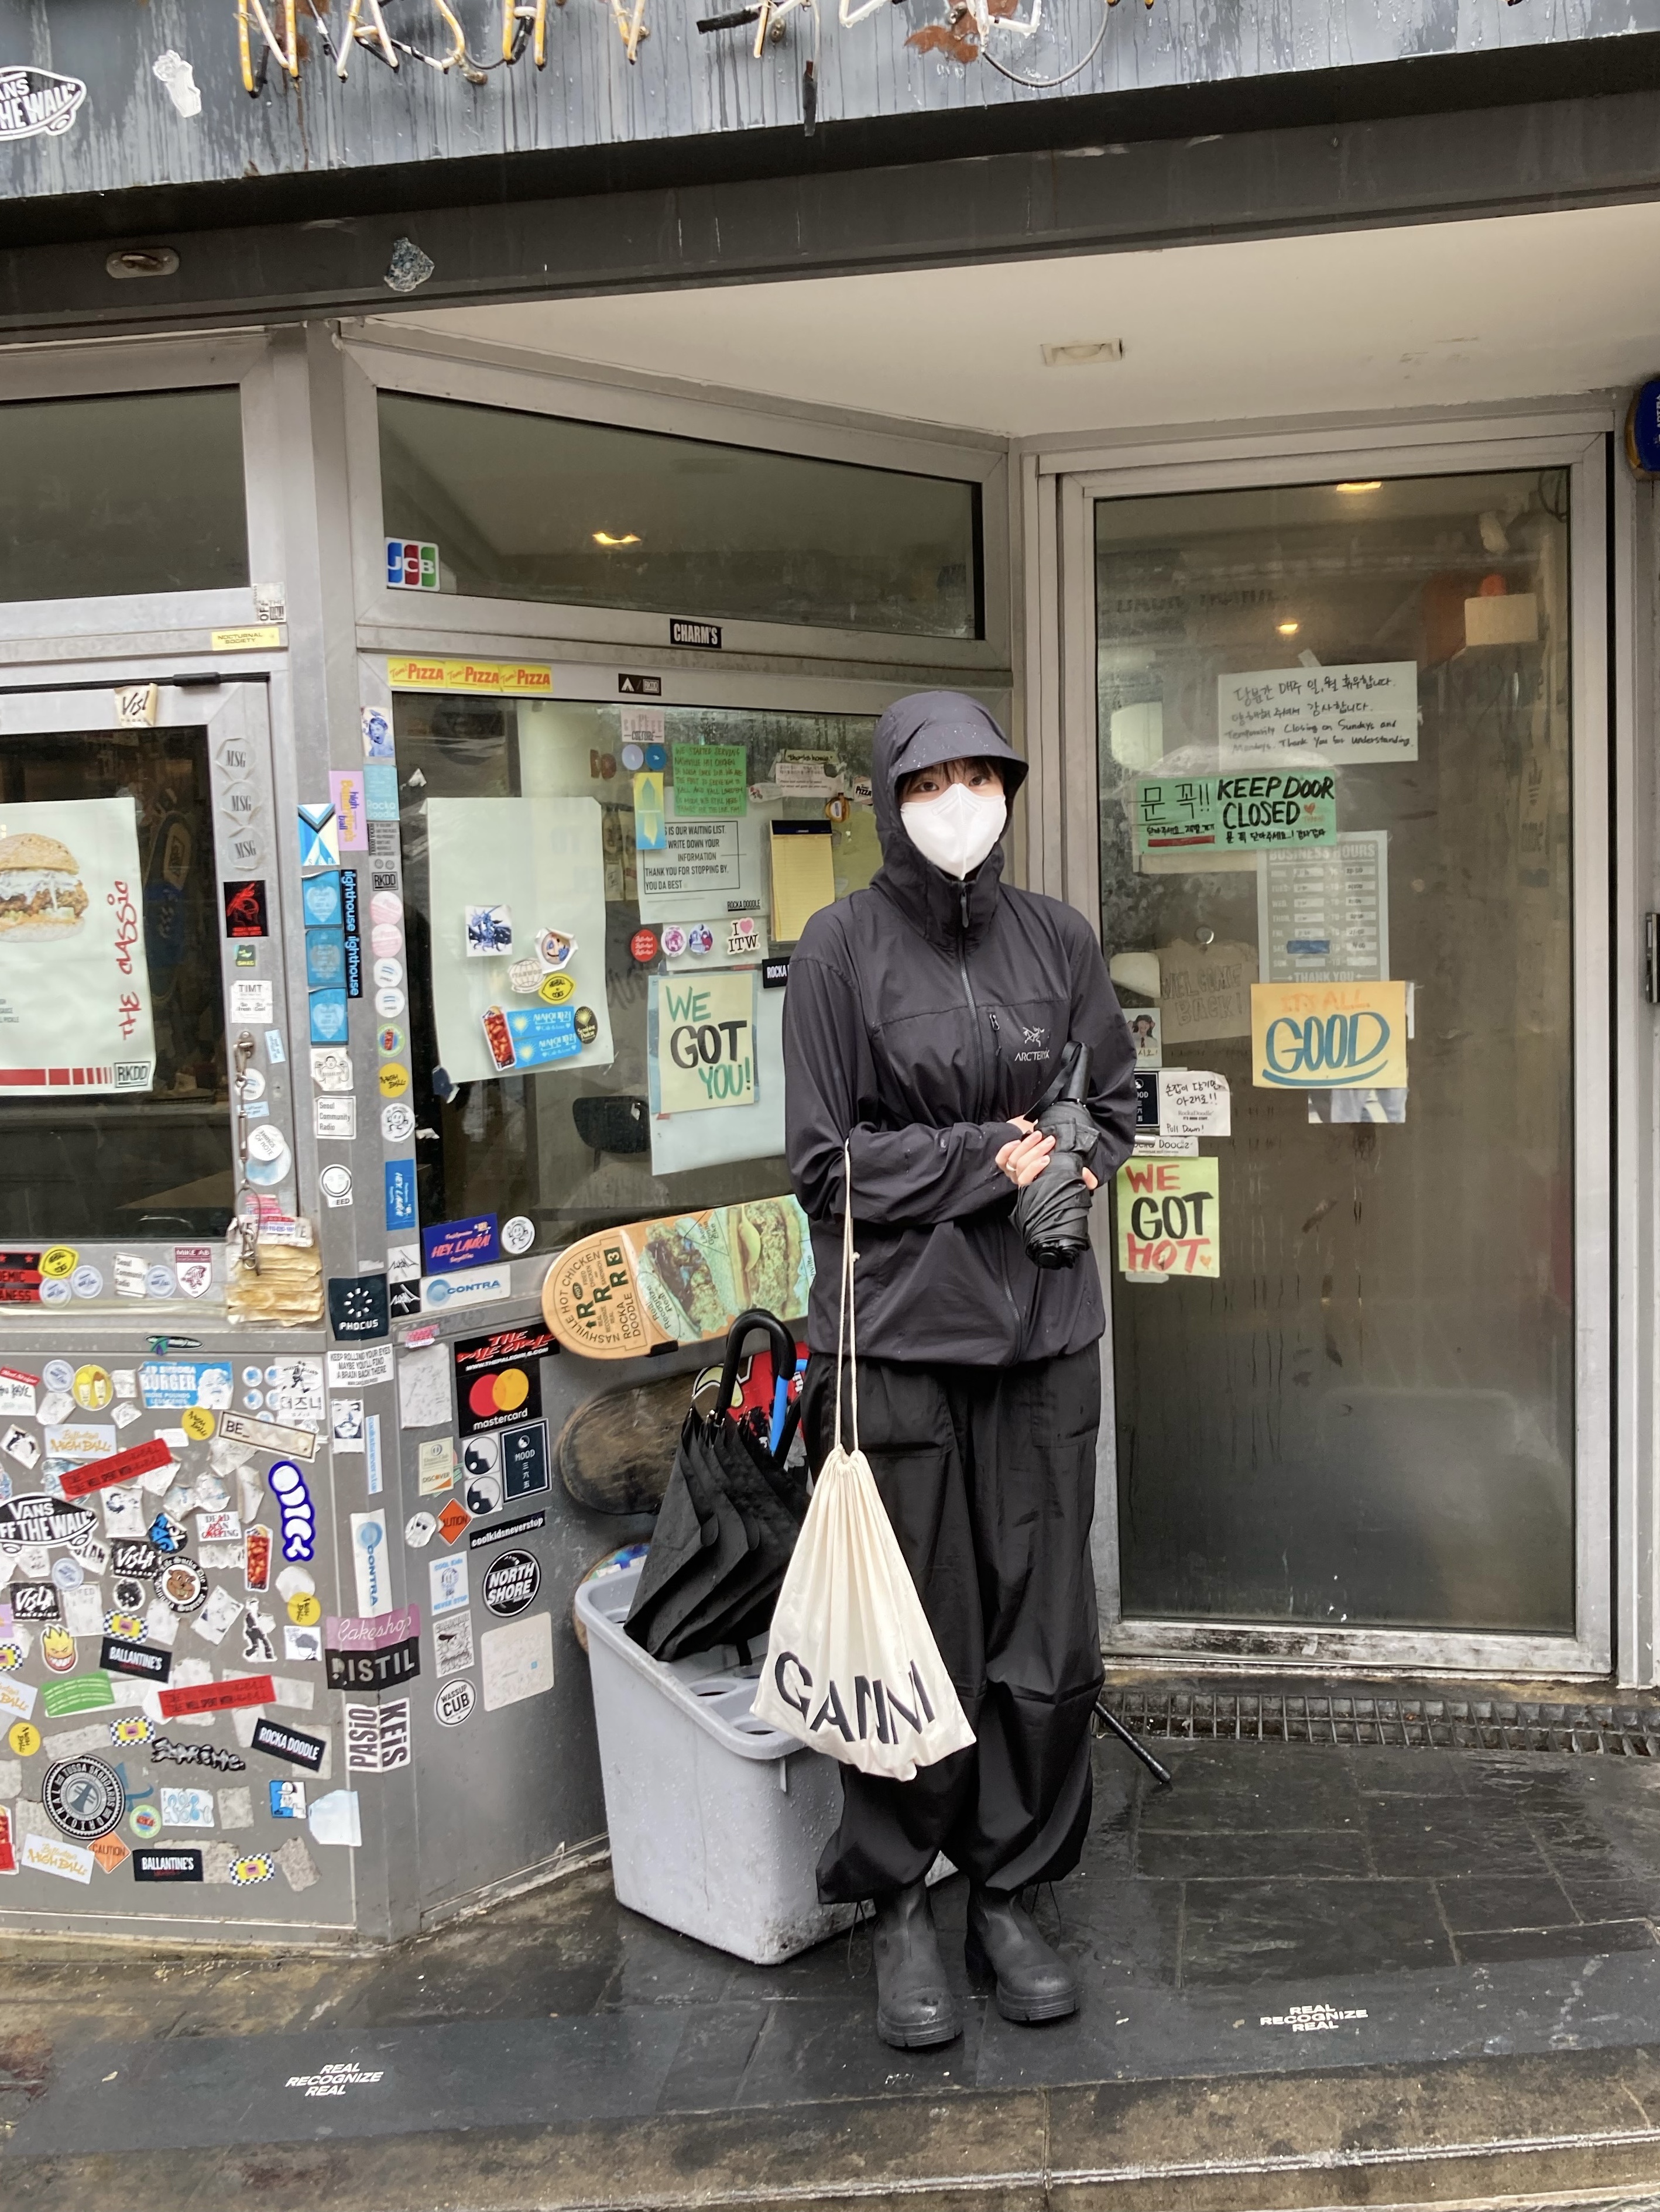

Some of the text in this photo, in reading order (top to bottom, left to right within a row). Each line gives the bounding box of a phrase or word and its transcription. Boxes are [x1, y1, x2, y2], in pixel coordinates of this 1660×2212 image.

[387, 555, 435, 575] JCB
[217, 633, 263, 641] NOCTURNAL
[673, 623, 718, 645] CHARM'S
[408, 662, 444, 680] PIZZA
[465, 666, 499, 684] PIZZA
[517, 669, 551, 685] PIZZA
[1279, 682, 1302, 695] 매주
[1284, 723, 1318, 734] Closing
[1337, 719, 1374, 732] Sundays
[1380, 720, 1397, 728] and
[1279, 738, 1309, 748] Thank
[225, 751, 246, 768] MSG
[856, 786, 872, 797] PIZZA
[1217, 775, 1335, 801] KEEP DOOR
[231, 796, 252, 812] MSG
[1140, 786, 1166, 822] 문
[338, 815, 348, 830] ball
[1223, 800, 1301, 830] CLOSED
[668, 827, 674, 836] IS
[675, 826, 687, 836] OUR
[688, 826, 712, 835] WAITING
[235, 840, 256, 859] MSG
[668, 839, 720, 849] WRITE DOWN YOUR
[1269, 844, 1376, 860] BUSINESS HOURS
[678, 852, 716, 862] INFORMATION
[645, 865, 719, 877] THANK YOU FOR STOPPING
[374, 874, 396, 887] RKDD
[645, 880, 682, 891] YOU DA BEST
[341, 870, 356, 932] lighthouse
[733, 922, 739, 936] I
[345, 935, 360, 997] lighthouse
[766, 964, 787, 980] ROCKA
[1294, 970, 1354, 983] THANK YOU
[666, 985, 711, 1023] WE
[1322, 989, 1370, 1011] ALL
[670, 1020, 747, 1069] GOT
[1265, 1011, 1391, 1074] GOOD
[117, 1066, 148, 1082] RKDD
[698, 1056, 751, 1100] YOU!
[1165, 1083, 1189, 1097] 손잡이
[319, 1101, 335, 1110] Seoul
[319, 1112, 351, 1122] Community
[1167, 1123, 1205, 1134] Pull Down!
[1124, 1165, 1181, 1194] WE
[1131, 1191, 1215, 1241] GOT
[704, 1221, 715, 1245] Gonna
[1126, 1233, 1212, 1273] HOT
[563, 1250, 602, 1287] CHICKEN
[447, 1278, 501, 1296] CONTRA
[576, 1253, 630, 1320] R R R 3
[647, 1285, 672, 1330] Recognize
[660, 1292, 673, 1313] Real
[617, 1301, 633, 1339] ROCKA
[624, 1292, 642, 1337] DOODLE
[646, 1303, 660, 1321] Real
[339, 1318, 379, 1331] PHOCUS
[489, 1330, 529, 1347] THE
[330, 1345, 392, 1361] KEEP ROLLING YOUR EYES
[338, 1362, 355, 1370] MAYBE
[372, 1356, 385, 1366] FIND
[342, 1371, 358, 1379] BRAIN
[358, 1368, 372, 1379] BACK
[371, 1365, 387, 1375] THERE
[473, 1407, 528, 1431] mastercard
[514, 1448, 536, 1462] MOOD
[422, 1471, 451, 1483] DISCOVER
[8, 1497, 56, 1520] VANS
[18, 1519, 53, 1541] THE
[471, 1517, 544, 1548] coolkidsneverstop
[488, 1562, 536, 1590] NORTH
[486, 1578, 533, 1604] SHORE
[338, 1612, 412, 1641] Cakeshop
[109, 1646, 163, 1671] BALLANTINE'S
[441, 1684, 468, 1703] WASSUP
[443, 1692, 470, 1718] CUB
[258, 1726, 321, 1761] ROCKA DOODLE
[91, 1843, 126, 1857] CAUTION
[142, 1856, 195, 1871] BALLANTINE'S
[1260, 2009, 1369, 2025] RECOGNIZE
[1289, 2004, 1336, 2015] REAL
[1292, 2020, 1339, 2032] REAL
[320, 2062, 361, 2074] REAL
[285, 2071, 385, 2087] RECOGNIZE
[304, 2084, 347, 2097] REAL
